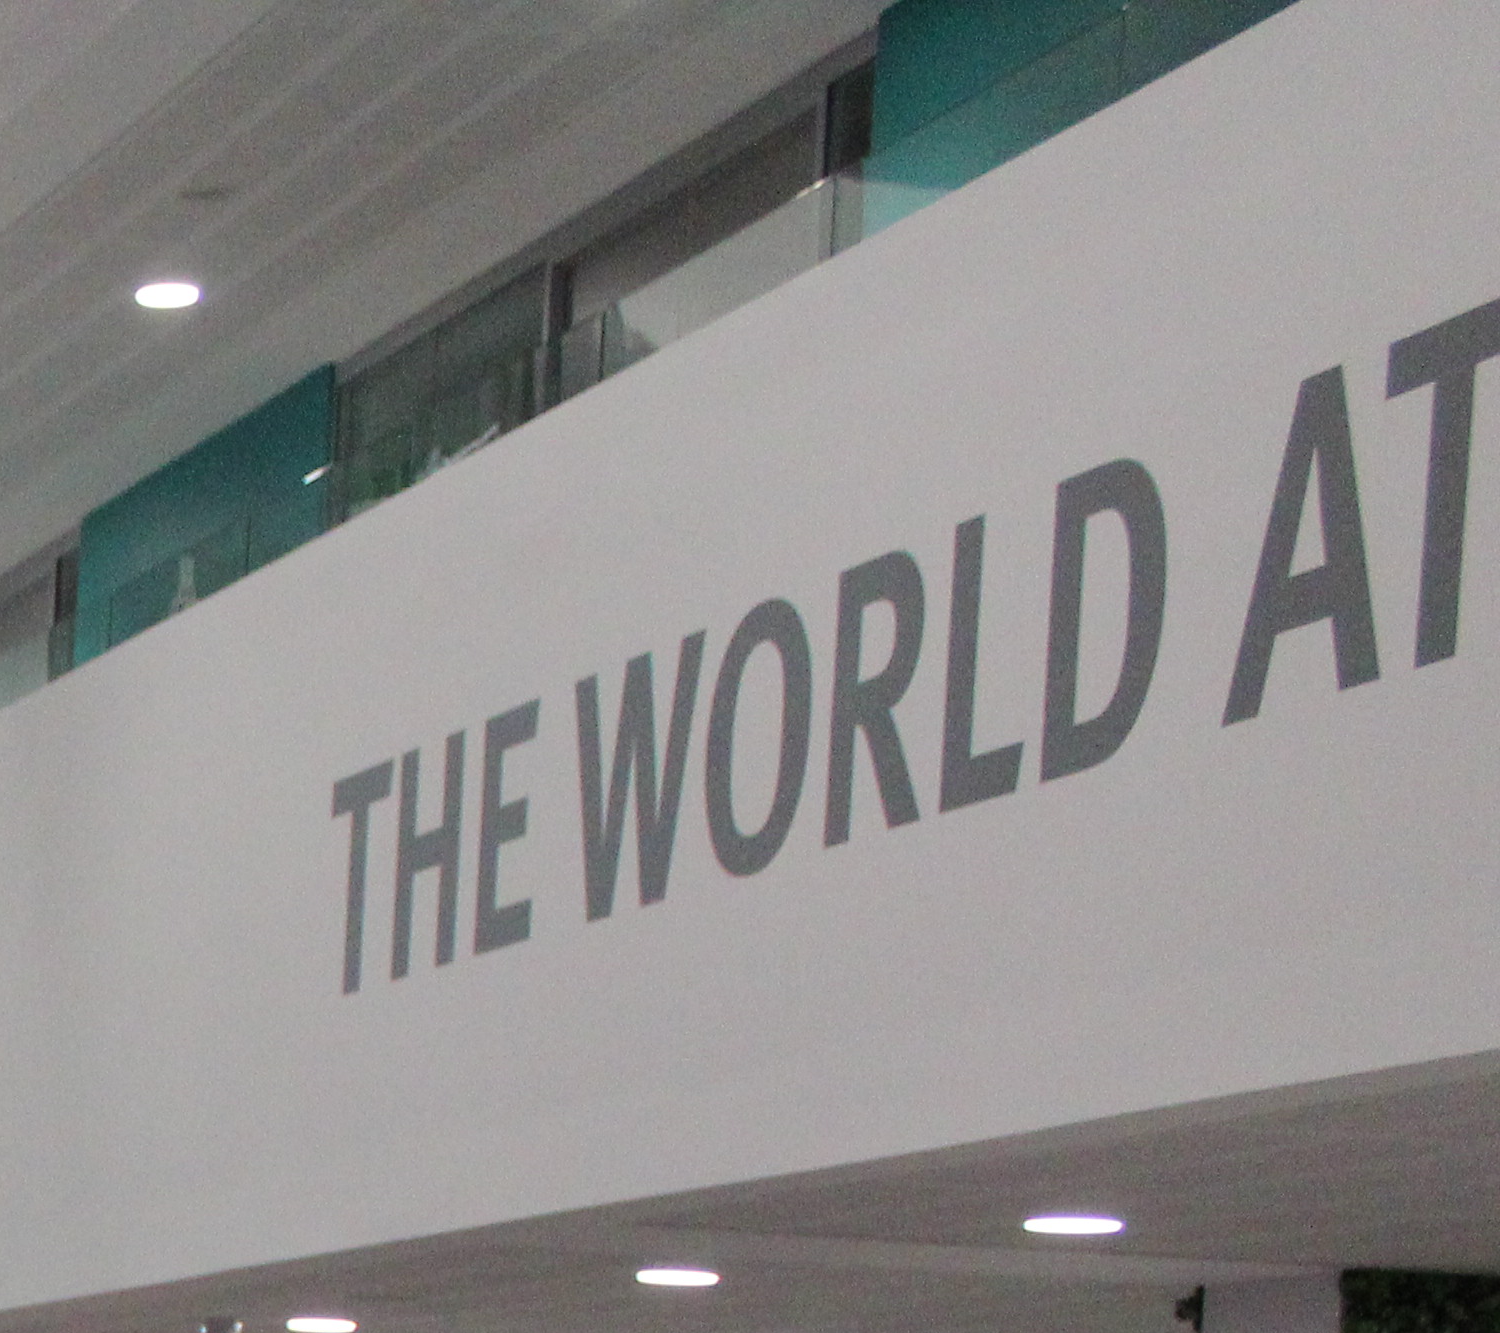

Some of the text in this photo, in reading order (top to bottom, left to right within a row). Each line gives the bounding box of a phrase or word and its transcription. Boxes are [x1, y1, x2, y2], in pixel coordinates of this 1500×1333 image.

[332, 296, 1500, 997] THE WORLD AT
